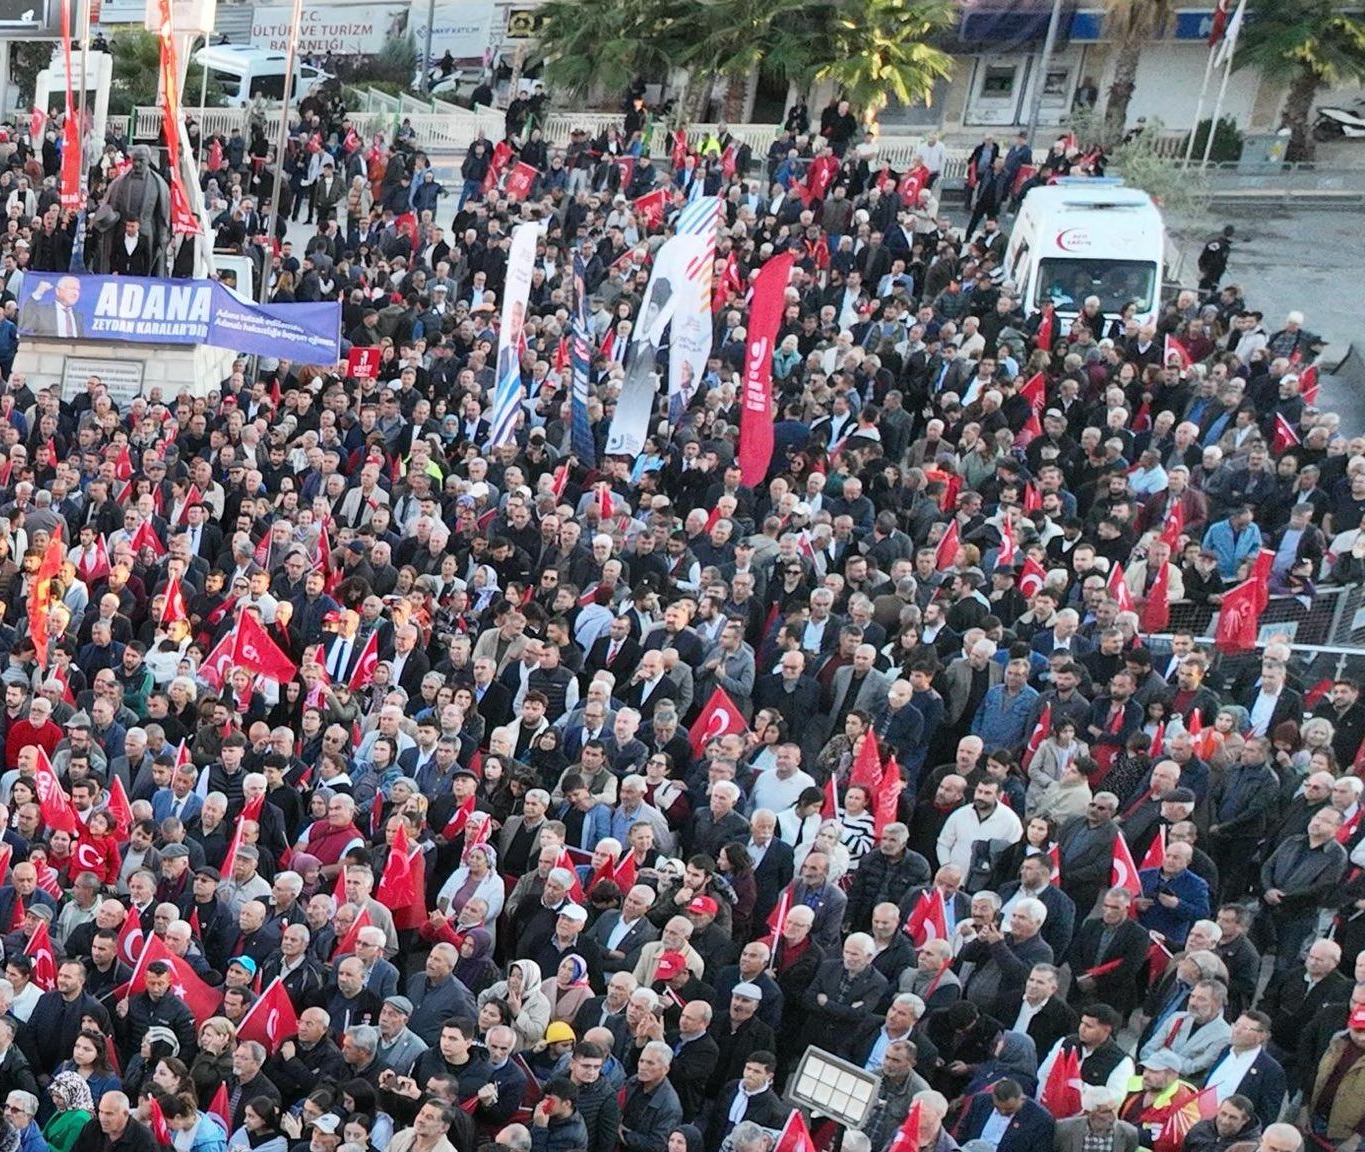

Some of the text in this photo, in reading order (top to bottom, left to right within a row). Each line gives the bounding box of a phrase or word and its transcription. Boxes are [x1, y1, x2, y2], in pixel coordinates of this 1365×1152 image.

[252, 23, 374, 37] ÜLTÜR VE TURİZM
[270, 39, 345, 51] BAANLIĞI
[94, 281, 213, 325] ADANA
[91, 318, 209, 339] ZEYDAN KARALAR'DIR
